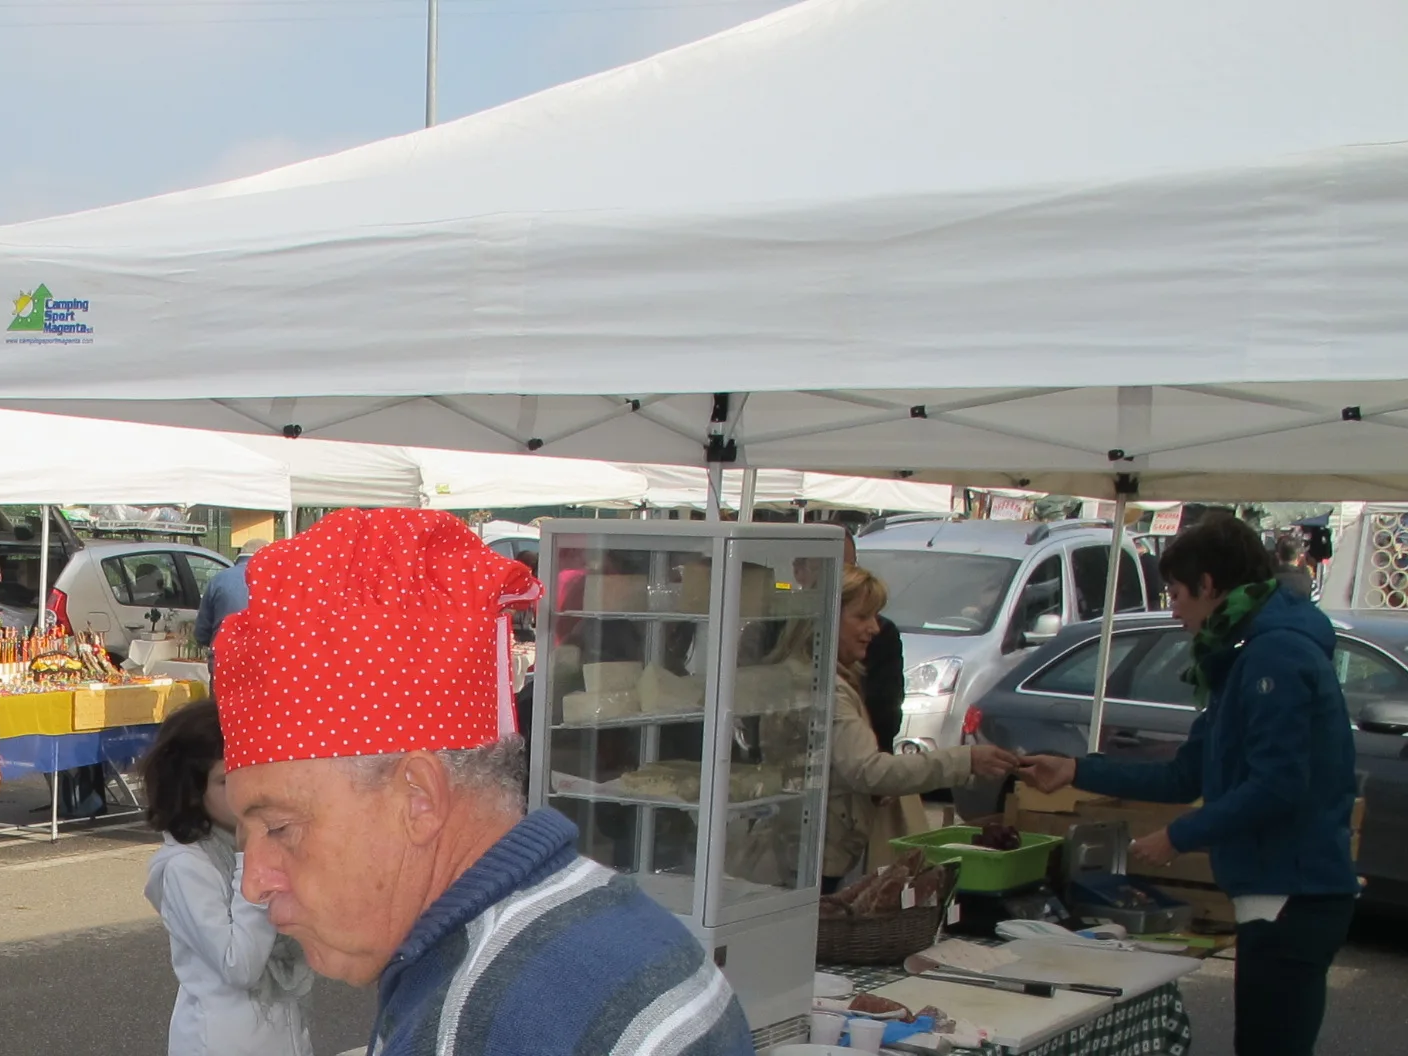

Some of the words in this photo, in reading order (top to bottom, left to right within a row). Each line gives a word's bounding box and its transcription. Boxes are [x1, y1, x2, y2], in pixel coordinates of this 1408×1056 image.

[45, 298, 89, 312] Camping
[44, 310, 75, 323] Sport
[43, 322, 87, 335] Magenta
